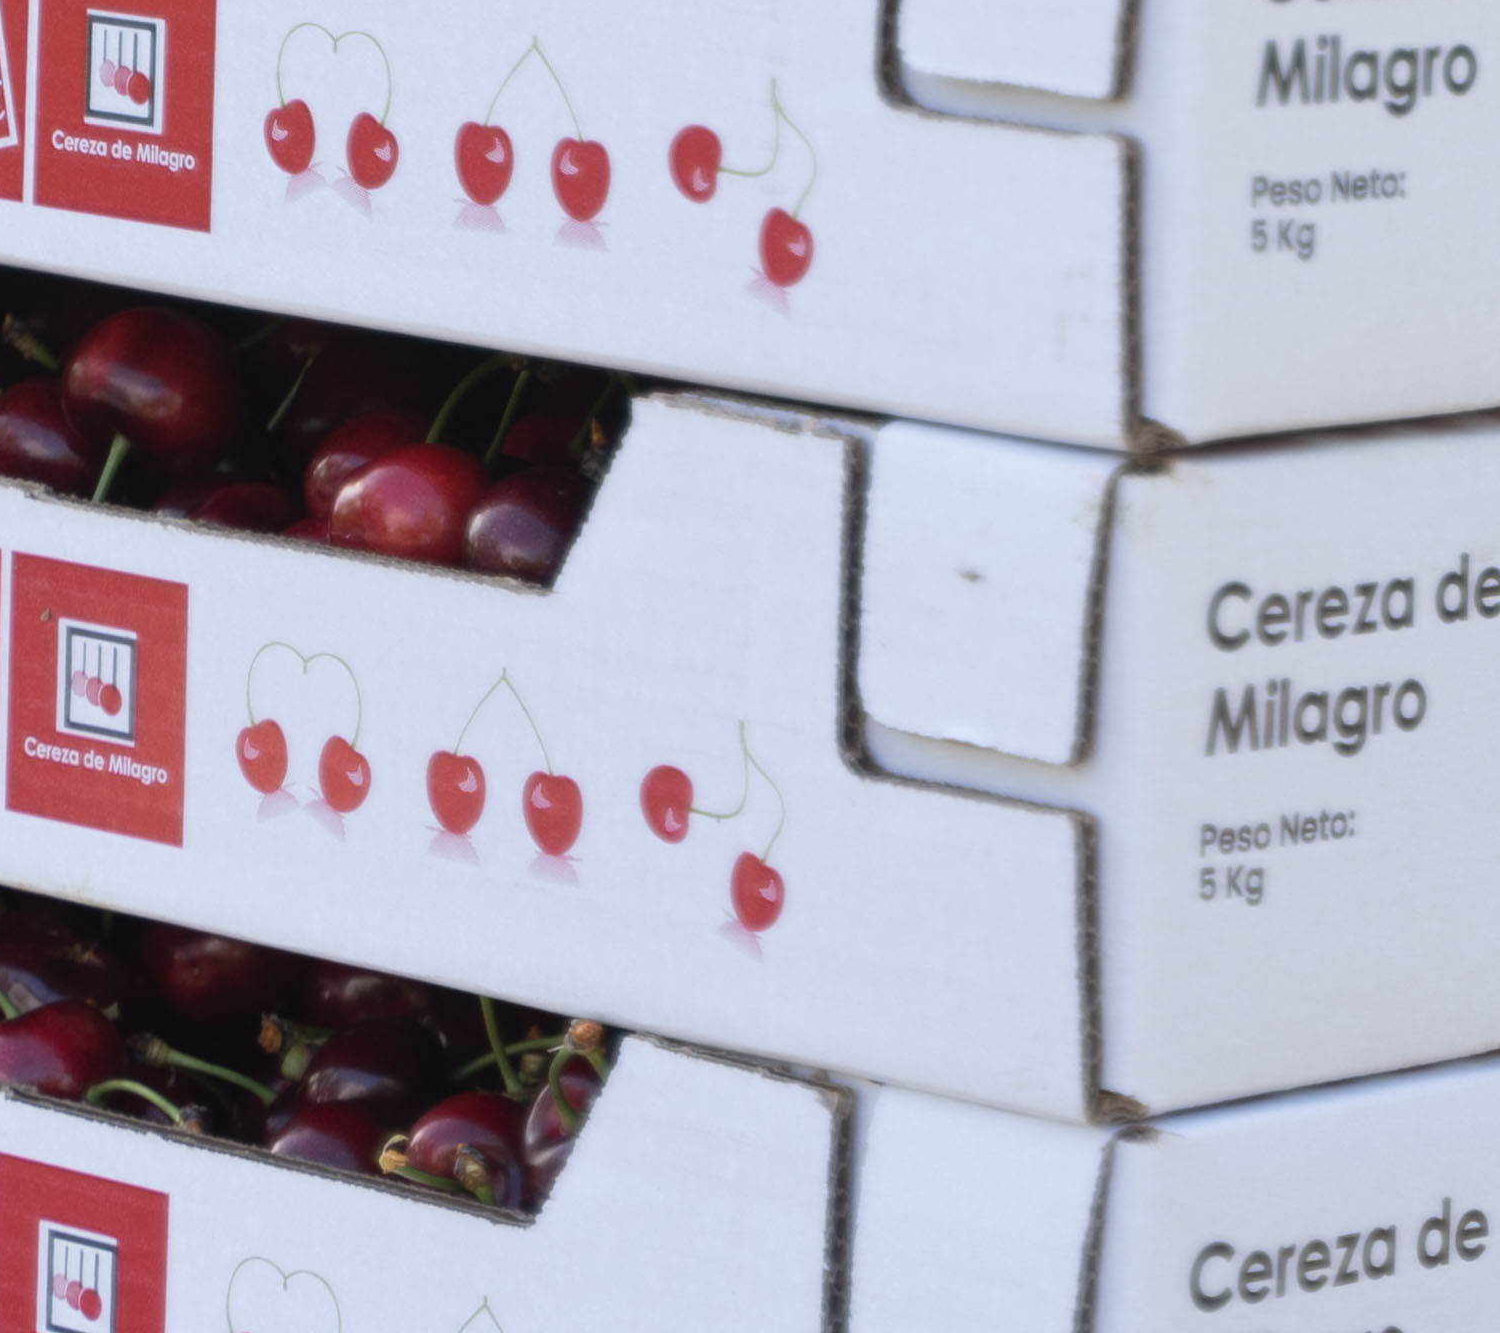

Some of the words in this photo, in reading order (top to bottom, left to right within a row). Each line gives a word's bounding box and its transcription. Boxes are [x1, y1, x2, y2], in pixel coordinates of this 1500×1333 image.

[1255, 34, 1477, 117] Milagro
[52, 131, 107, 157] Cereza
[111, 140, 132, 161] de
[136, 144, 195, 172] Milagro
[1251, 176, 1322, 207] Peso
[1331, 170, 1406, 203] Neto:
[1251, 220, 1267, 253] 5
[1277, 220, 1316, 261] Kg
[1207, 577, 1414, 652] Cereza
[1205, 677, 1427, 757] Milagro
[24, 737, 79, 765] Cereza
[84, 749, 104, 771] de
[109, 755, 167, 785] Milagro
[1199, 823, 1271, 857] Peso
[1280, 809, 1356, 846] Neto:
[1199, 867, 1216, 901] 5
[1226, 865, 1264, 906] Kg
[1190, 1224, 1396, 1313] Cereza
[1417, 1196, 1489, 1269] de
